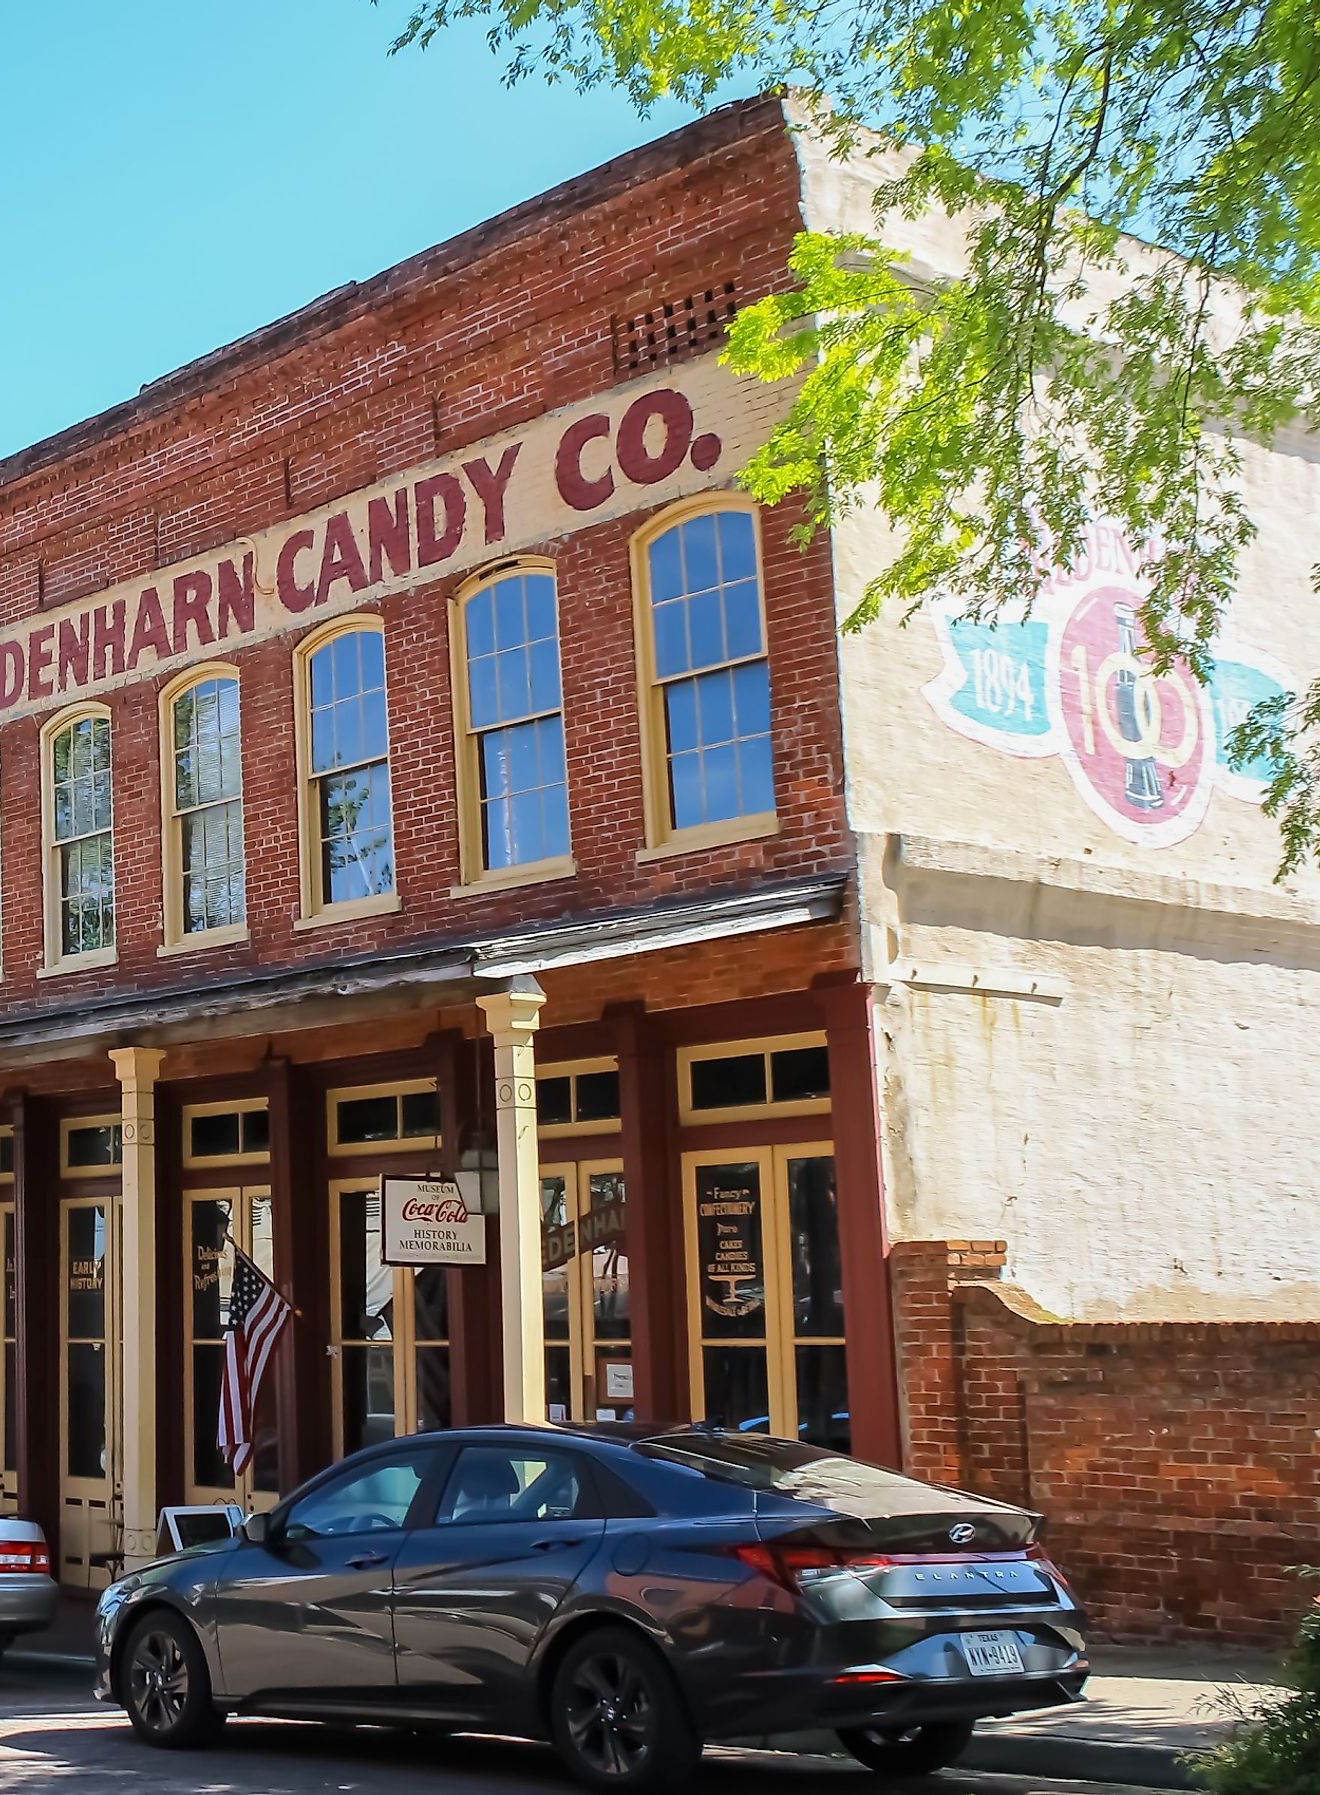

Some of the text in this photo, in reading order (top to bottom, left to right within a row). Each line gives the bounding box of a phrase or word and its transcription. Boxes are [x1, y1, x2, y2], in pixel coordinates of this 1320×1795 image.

[277, 441, 524, 614] CANDY
[556, 388, 722, 512] CO.
[971, 648, 1034, 721] 1894
[1071, 645, 1199, 768] 100
[417, 1184, 454, 1193] MUSEUM
[713, 1187, 741, 1199] Fancy
[402, 1198, 468, 1223] Coca-Cola
[414, 1229, 457, 1240] HISTORY
[400, 1240, 472, 1251] MEMORABILIA
[715, 1251, 748, 1261] CANDIES
[72, 1261, 101, 1274] EARLY
[716, 1263, 730, 1272] ALL
[731, 1262, 756, 1272] KINDS
[915, 1570, 1018, 1580] ELANTRA
[977, 1633, 999, 1643] TEXAS
